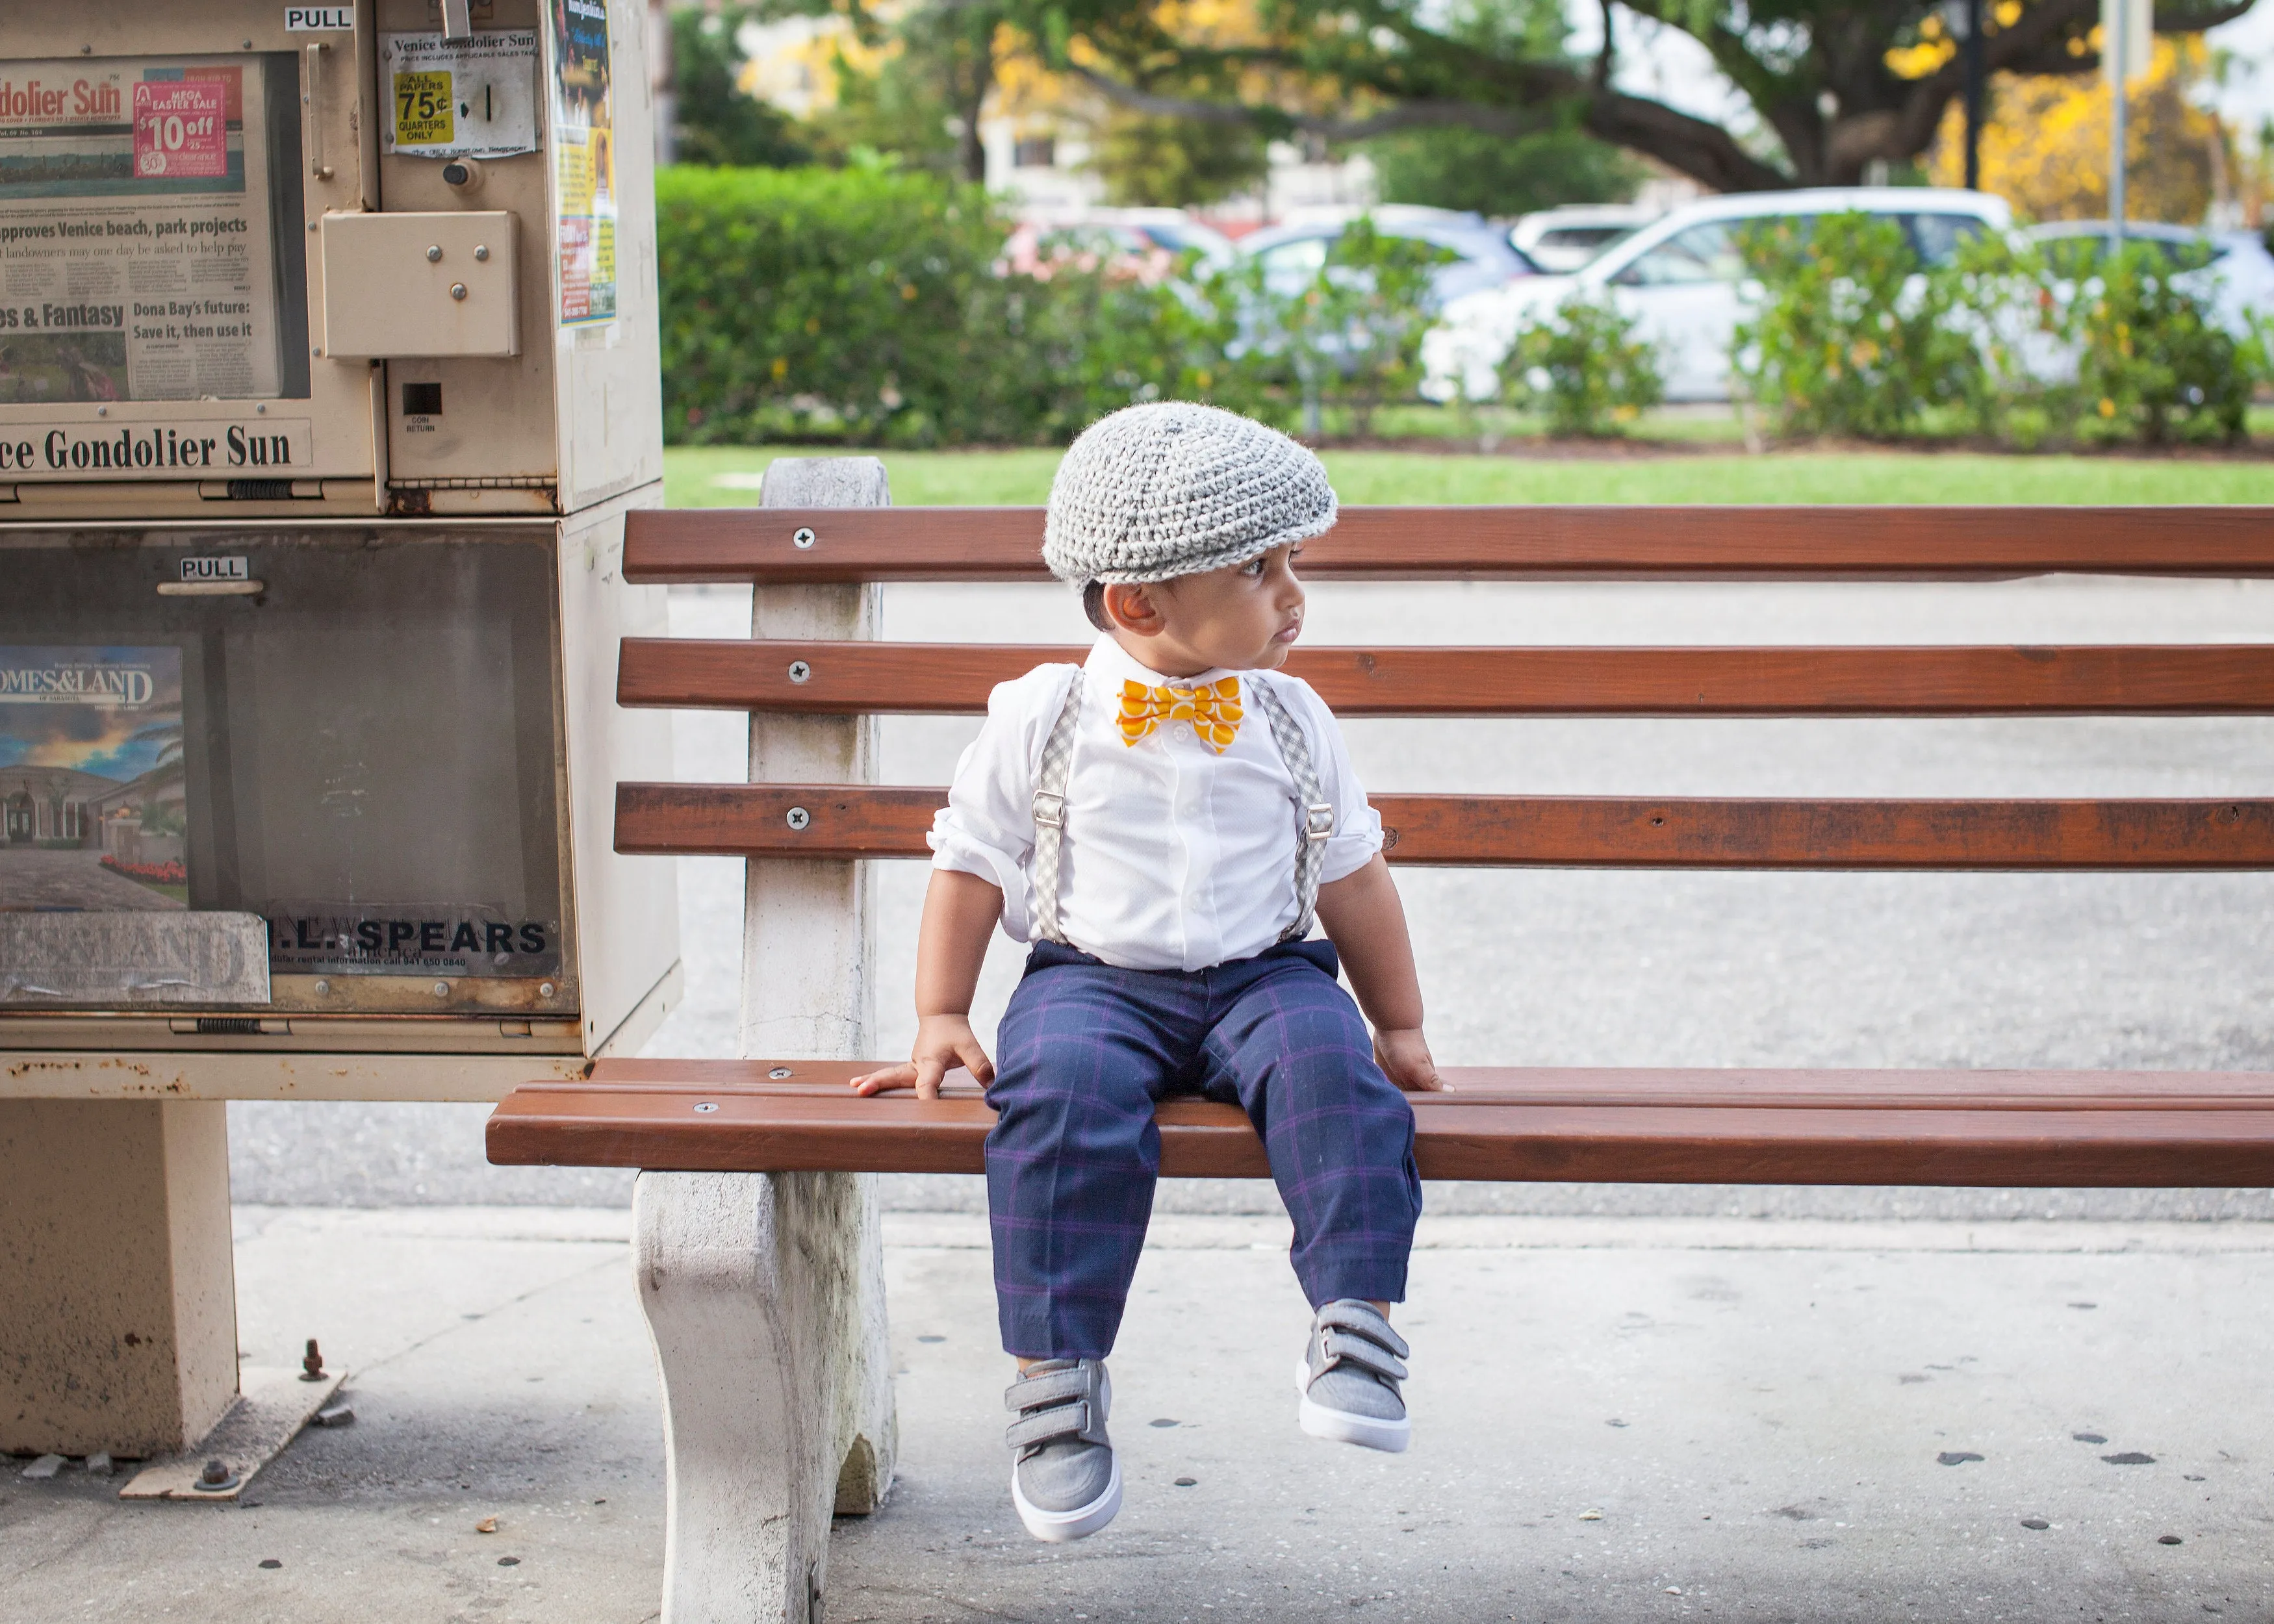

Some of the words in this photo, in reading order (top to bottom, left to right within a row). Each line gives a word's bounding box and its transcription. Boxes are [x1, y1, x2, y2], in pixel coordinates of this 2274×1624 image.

[289, 10, 351, 27] PULL
[394, 38, 436, 52] Venice
[509, 34, 533, 46] Sun
[421, 53, 454, 61] INCLUDES
[455, 51, 496, 60] APPLICABLE
[497, 49, 518, 58] SALES
[400, 82, 443, 92] PAPERS
[408, 75, 431, 84] ALL
[73, 78, 121, 115] Sun
[152, 99, 188, 110] EASTER
[193, 98, 217, 110] SALE
[172, 90, 202, 101] MEGA
[399, 91, 447, 120] 75¢
[139, 116, 185, 151] $10
[186, 116, 214, 136] off
[399, 120, 446, 131] QUARTERS
[407, 130, 433, 140] ONLY
[0, 225, 55, 243] pproves
[58, 220, 103, 238] Venice
[107, 218, 152, 238] beach,
[156, 218, 187, 238] park
[190, 216, 248, 237] projects
[6, 246, 66, 259] landowners
[70, 247, 90, 260] may
[94, 247, 113, 257] one
[116, 244, 134, 259] day
[138, 242, 151, 255] be
[154, 241, 183, 254] asked
[186, 242, 198, 253] to
[201, 241, 224, 257] help
[228, 243, 246, 256] pay
[24, 307, 39, 329] &
[42, 303, 123, 328] Fantasy
[133, 303, 165, 316] Dona
[169, 301, 201, 318] Bay's
[204, 300, 249, 314] future:
[134, 325, 163, 339] Save
[166, 324, 181, 340] it,
[183, 323, 214, 338] then
[217, 325, 238, 337] use
[242, 322, 252, 336] it
[407, 424, 435, 433] RETURN
[0, 442, 34, 469] ce
[45, 428, 216, 469] Gondolier
[227, 425, 292, 466] Sun
[183, 560, 242, 577] PULL
[357, 920, 546, 954] SPEARS
[327, 956, 381, 965] information
[403, 958, 420, 966] 941
